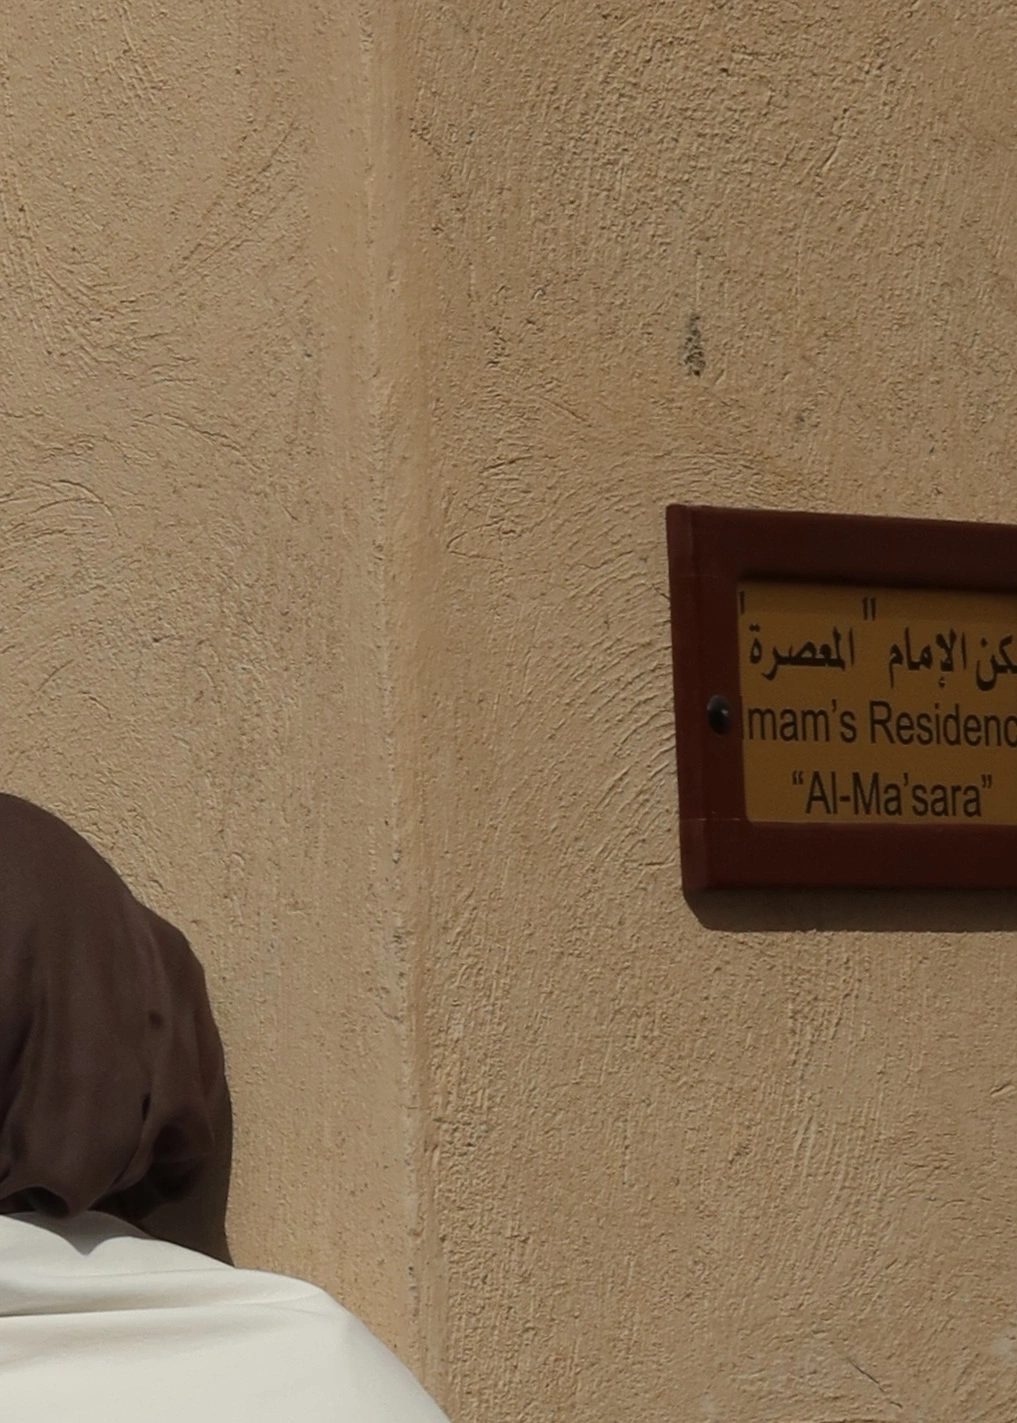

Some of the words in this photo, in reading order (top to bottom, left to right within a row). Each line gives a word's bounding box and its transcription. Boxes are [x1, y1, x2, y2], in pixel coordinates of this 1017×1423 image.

[889, 627, 967, 689] الإمام
[976, 634, 1017, 691] كن
[869, 700, 1017, 748] Residenc
[791, 770, 992, 818] “Al-Ma’sara”
